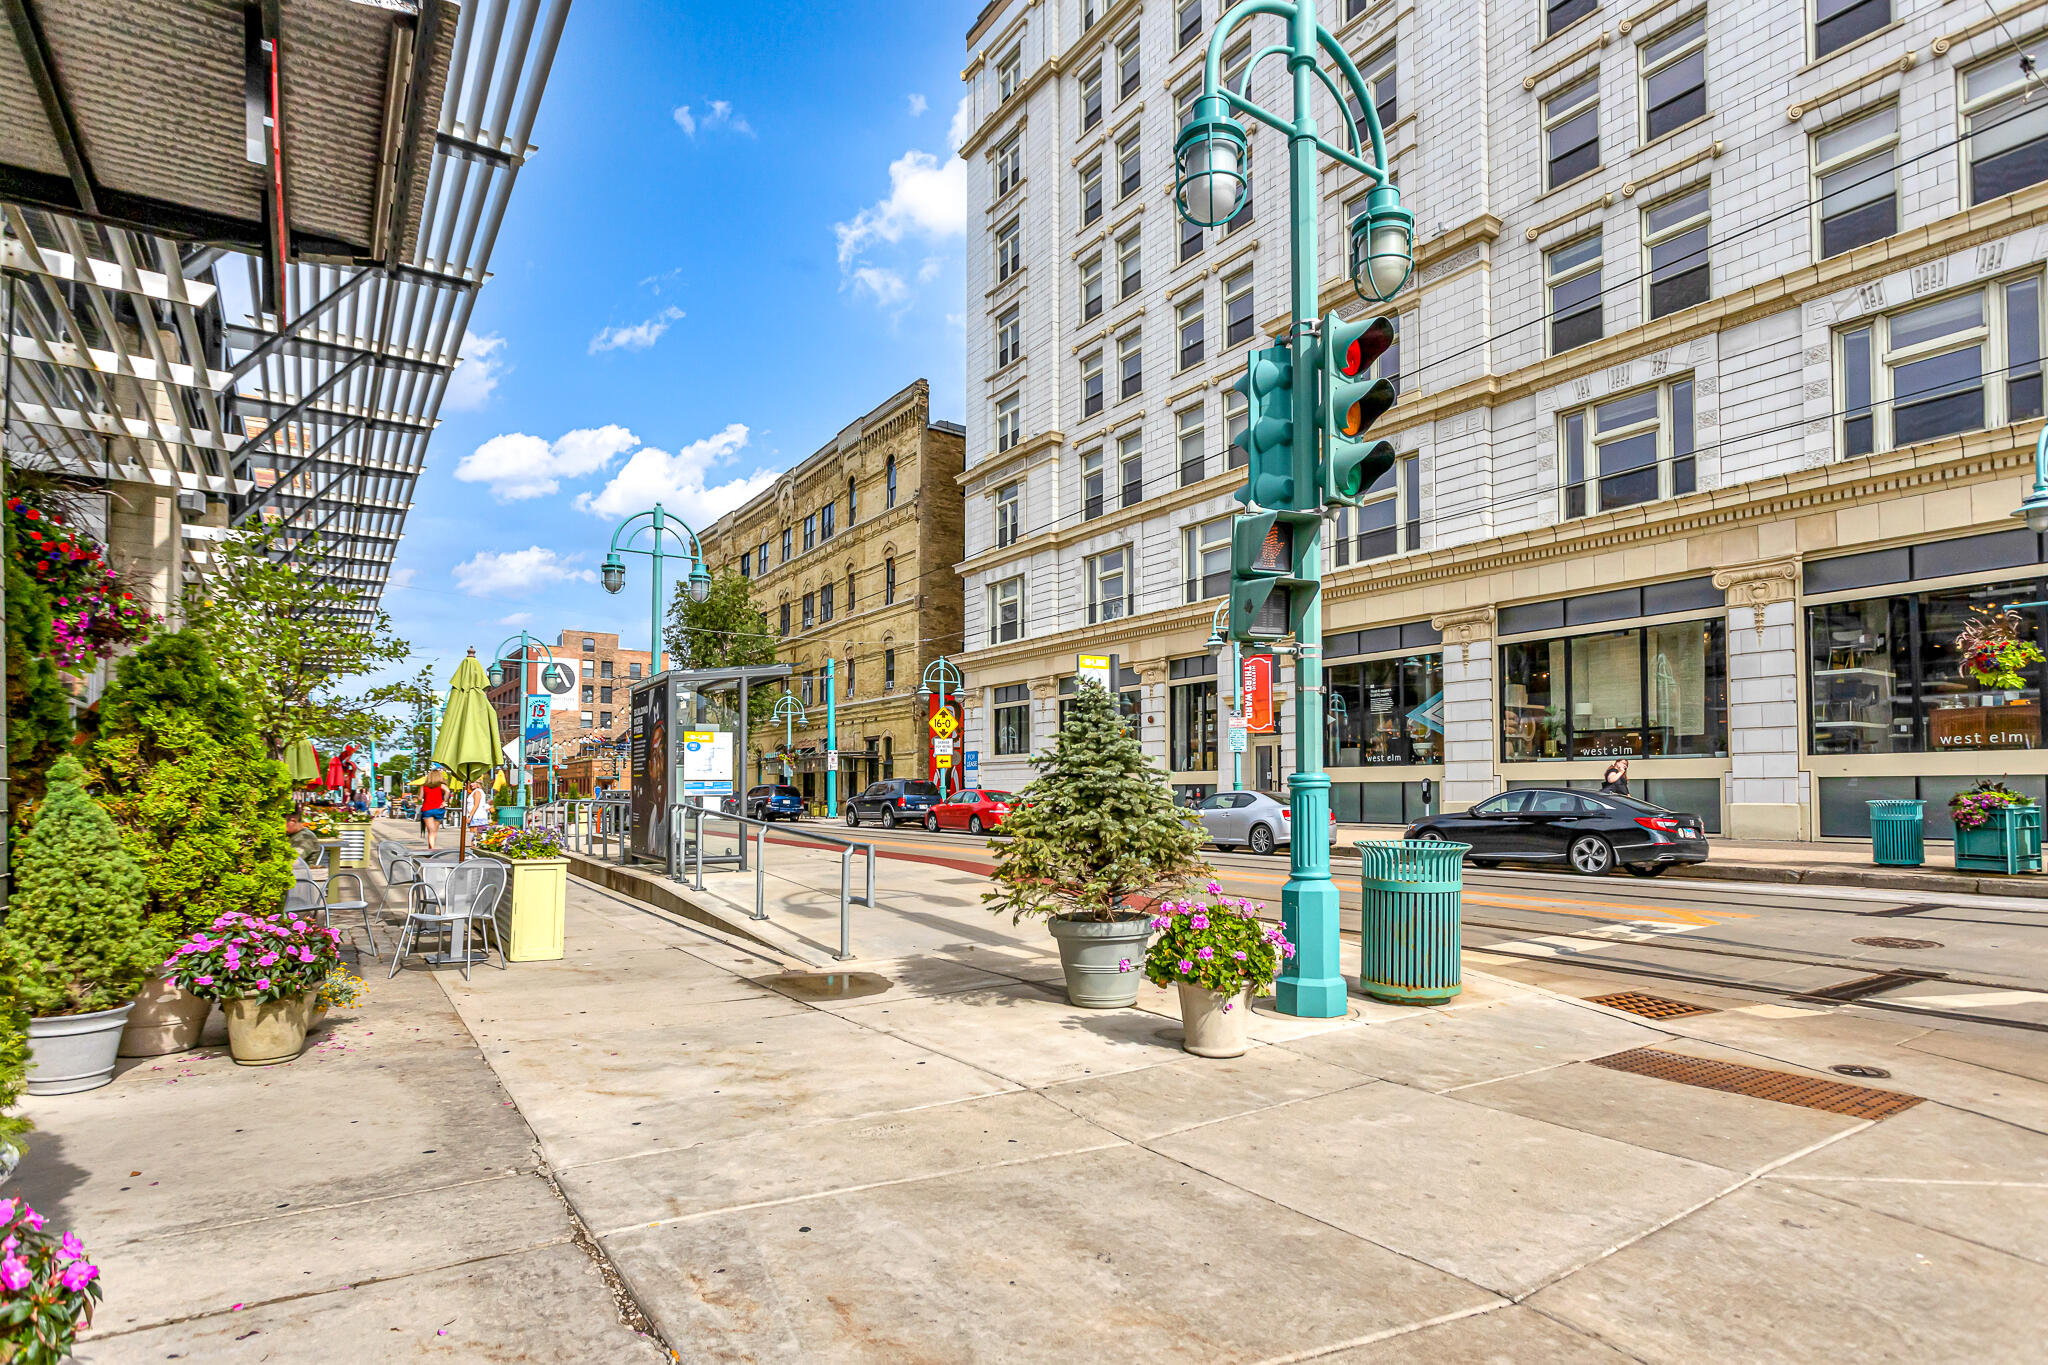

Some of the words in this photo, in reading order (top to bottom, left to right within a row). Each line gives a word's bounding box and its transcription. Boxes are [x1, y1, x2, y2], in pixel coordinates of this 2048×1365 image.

[1244, 665, 1252, 692] THIRD
[532, 704, 546, 718] 15
[1244, 693, 1253, 719] WARD
[1940, 732, 1982, 744] west
[1989, 731, 2023, 743] elm
[1583, 746, 1608, 756] west
[1612, 745, 1633, 755] elm
[966, 760, 978, 768] LEASE
[1366, 754, 1385, 762] west
[1386, 753, 1402, 762] elm
